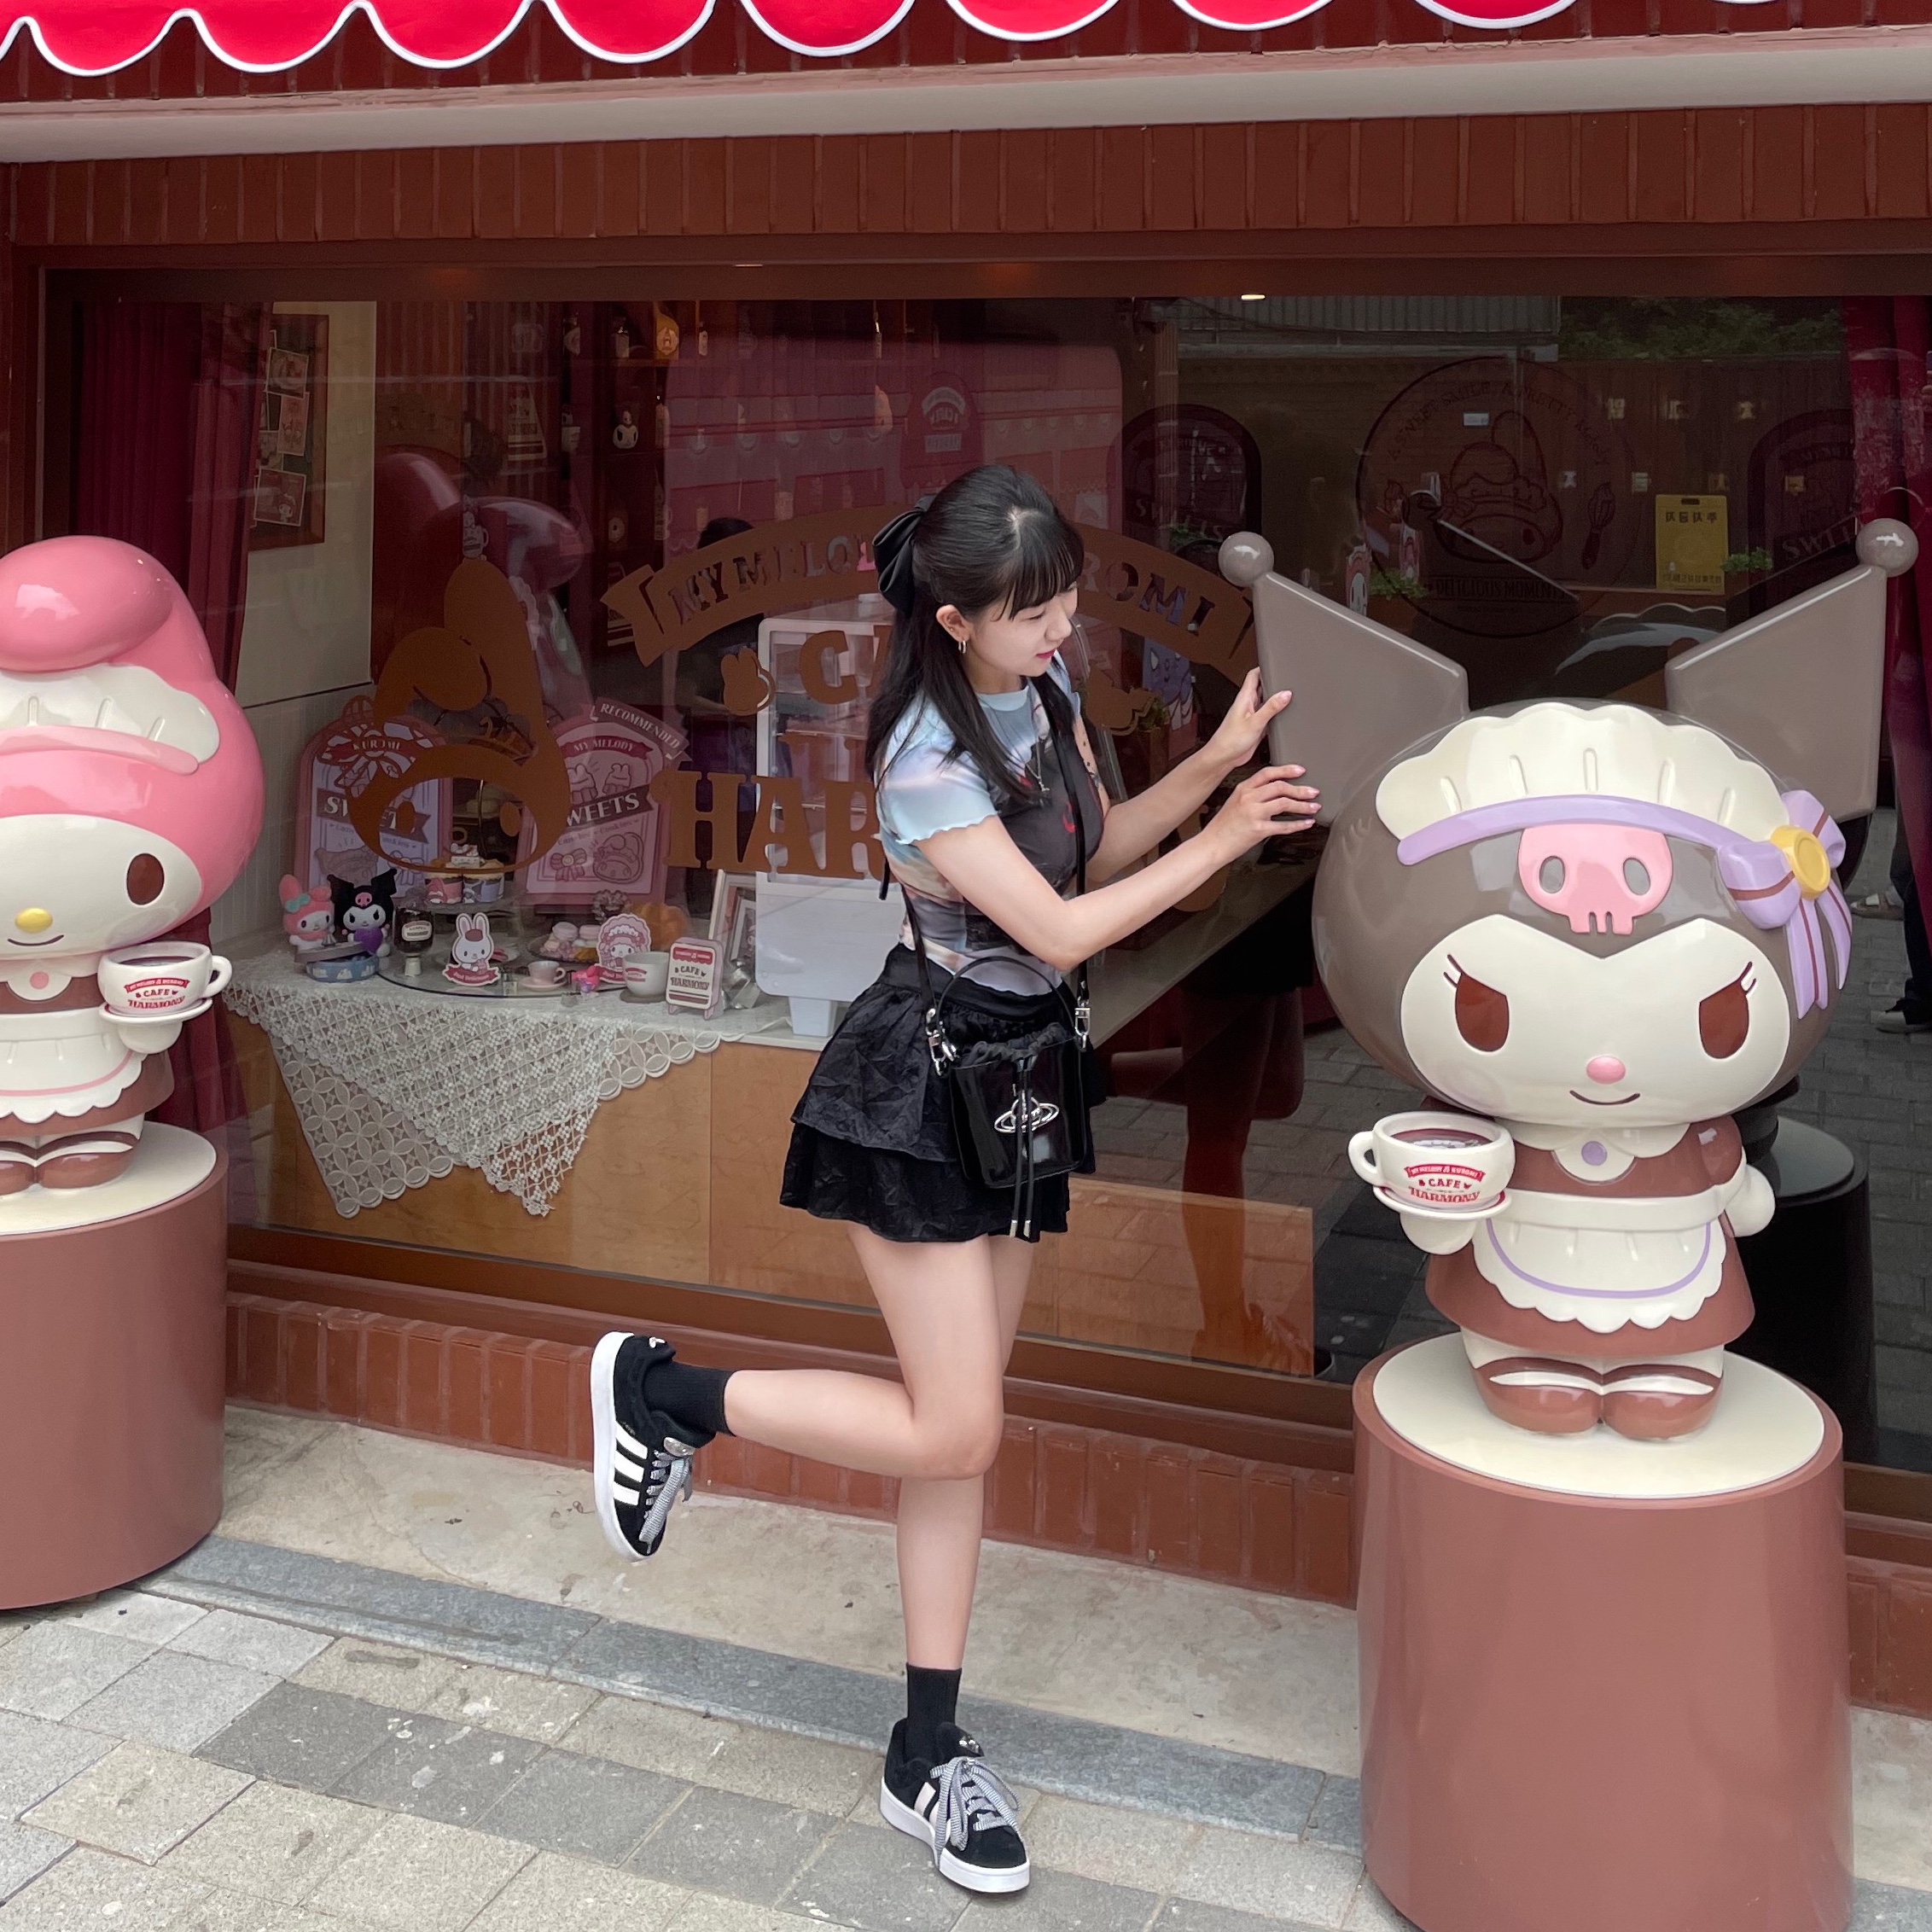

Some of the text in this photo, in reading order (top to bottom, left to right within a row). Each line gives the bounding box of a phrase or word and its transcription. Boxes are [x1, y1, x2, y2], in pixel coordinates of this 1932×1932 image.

[668, 562, 729, 625] MY
[601, 703, 680, 748] RECOMMENDED
[573, 739, 633, 753] MY MELODY
[567, 792, 641, 826] WEETS
[680, 965, 701, 975] CAFE
[671, 976, 710, 991] HARMONY
[128, 995, 186, 1009] HARMONY
[1429, 1178, 1461, 1189] CAFE
[1408, 1185, 1481, 1202] HARMONY
